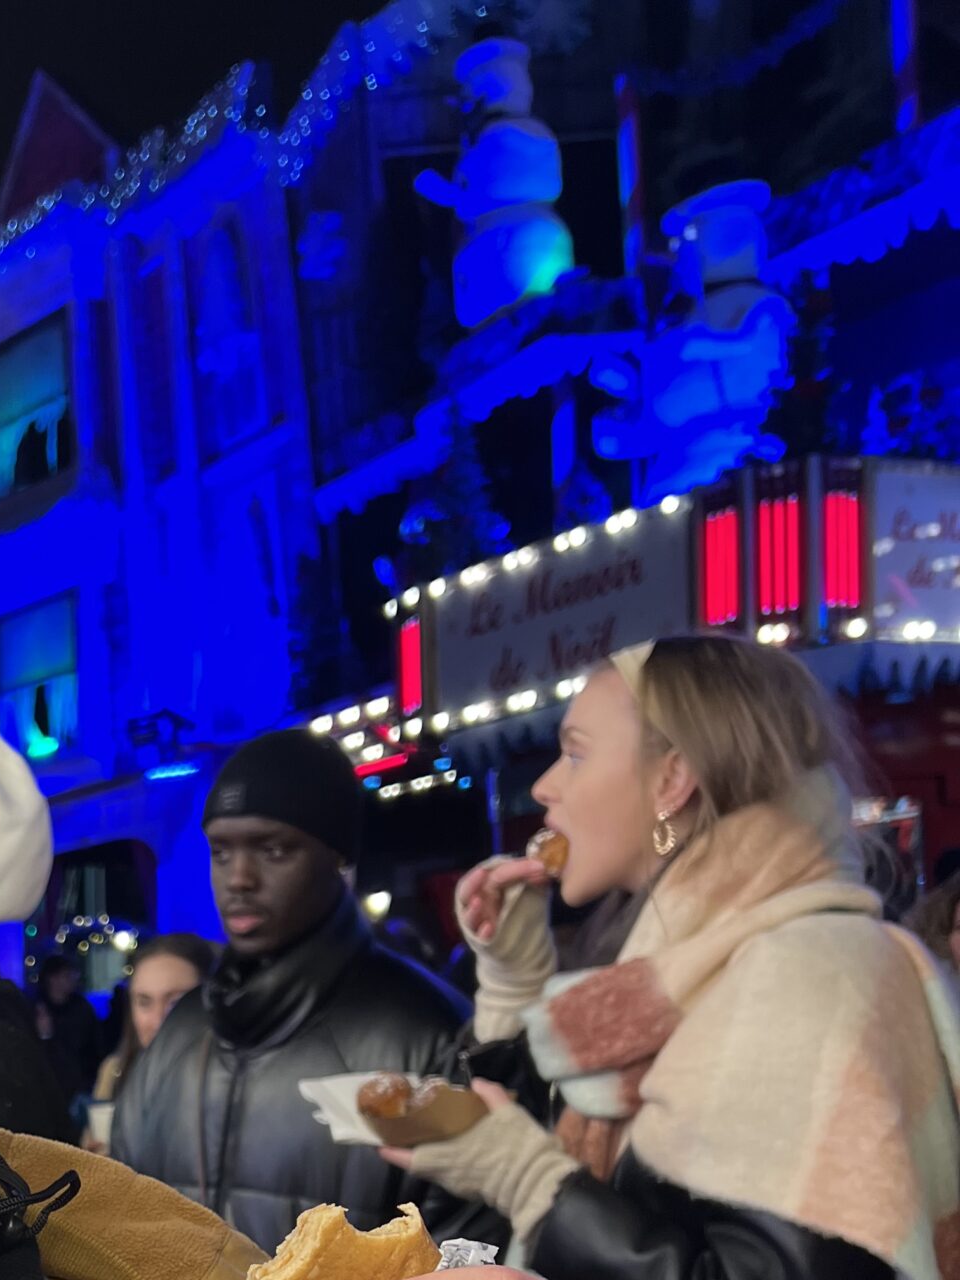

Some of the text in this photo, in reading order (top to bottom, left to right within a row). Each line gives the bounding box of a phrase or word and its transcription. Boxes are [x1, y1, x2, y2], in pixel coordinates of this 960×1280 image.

[464, 555, 644, 638] Le Manoir
[489, 646, 528, 692] de
